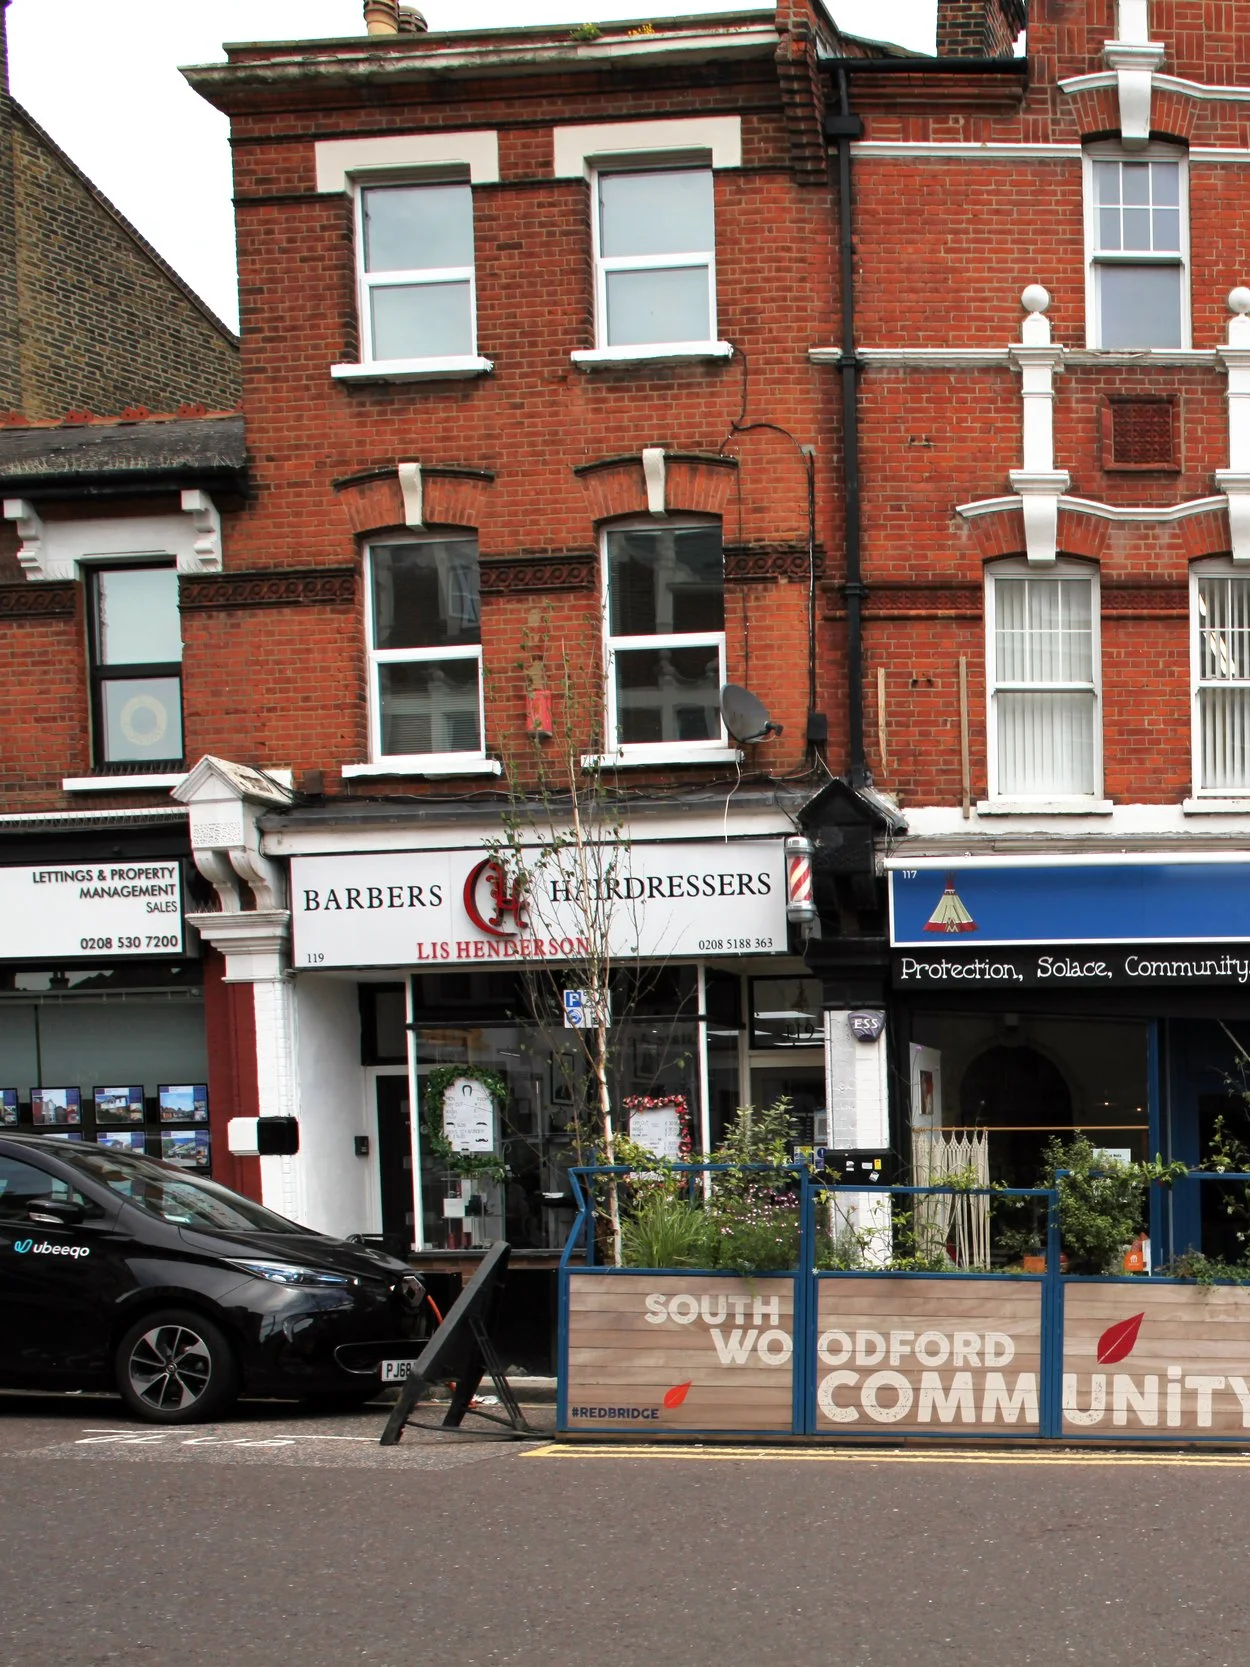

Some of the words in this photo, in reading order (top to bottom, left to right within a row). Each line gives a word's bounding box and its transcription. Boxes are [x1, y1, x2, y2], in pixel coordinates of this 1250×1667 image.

[33, 869, 93, 883] LETTINGS
[97, 870, 107, 881] &
[111, 867, 175, 880] PROPERTY
[902, 870, 917, 880] 117
[80, 884, 176, 899] MANAGEMENT
[551, 872, 771, 902] HAIRDRESSERS
[303, 885, 443, 911] BARBERS
[146, 901, 178, 913] SALES
[80, 937, 113, 950] 0208
[117, 936, 141, 948] 530
[145, 935, 178, 947] 7200
[417, 941, 449, 960] LIS
[456, 937, 591, 959] HENDERSON
[699, 939, 723, 950] 0208
[726, 938, 752, 949] 5188
[755, 937, 773, 948] 363
[307, 953, 325, 963] 119
[901, 958, 1024, 982] Protection,
[1037, 956, 1113, 979] Solace,
[854, 1018, 878, 1029] ESS
[33, 1241, 90, 1259] ubeeqo
[644, 1293, 780, 1325] SOUTH
[817, 1329, 1015, 1368] ODFORD
[817, 1370, 1040, 1424] COMM
[571, 1407, 660, 1419] #REDBRIDGE
